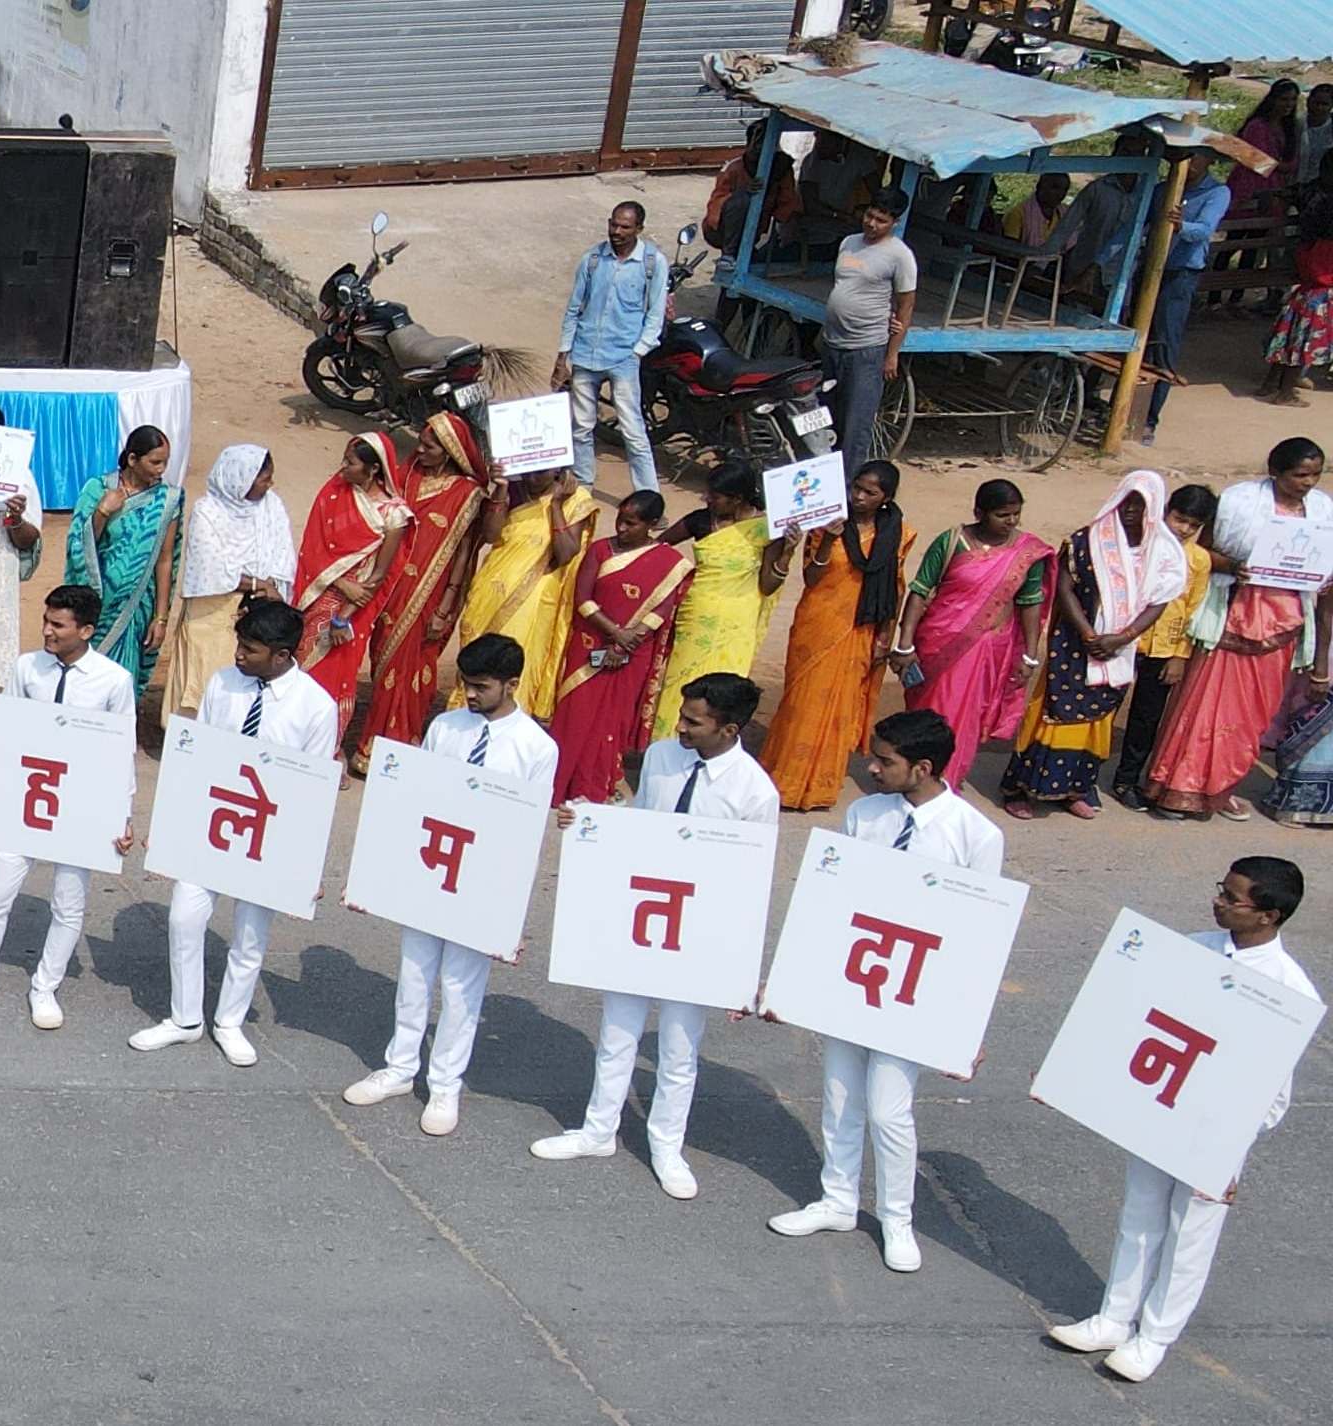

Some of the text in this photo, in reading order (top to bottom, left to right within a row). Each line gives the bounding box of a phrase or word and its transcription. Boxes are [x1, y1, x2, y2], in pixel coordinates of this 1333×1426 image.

[21, 755, 68, 831] ह
[208, 764, 278, 861] ले
[420, 816, 475, 893] म
[630, 875, 695, 951] त
[844, 912, 943, 1008] दा
[1129, 1007, 1217, 1109] न
